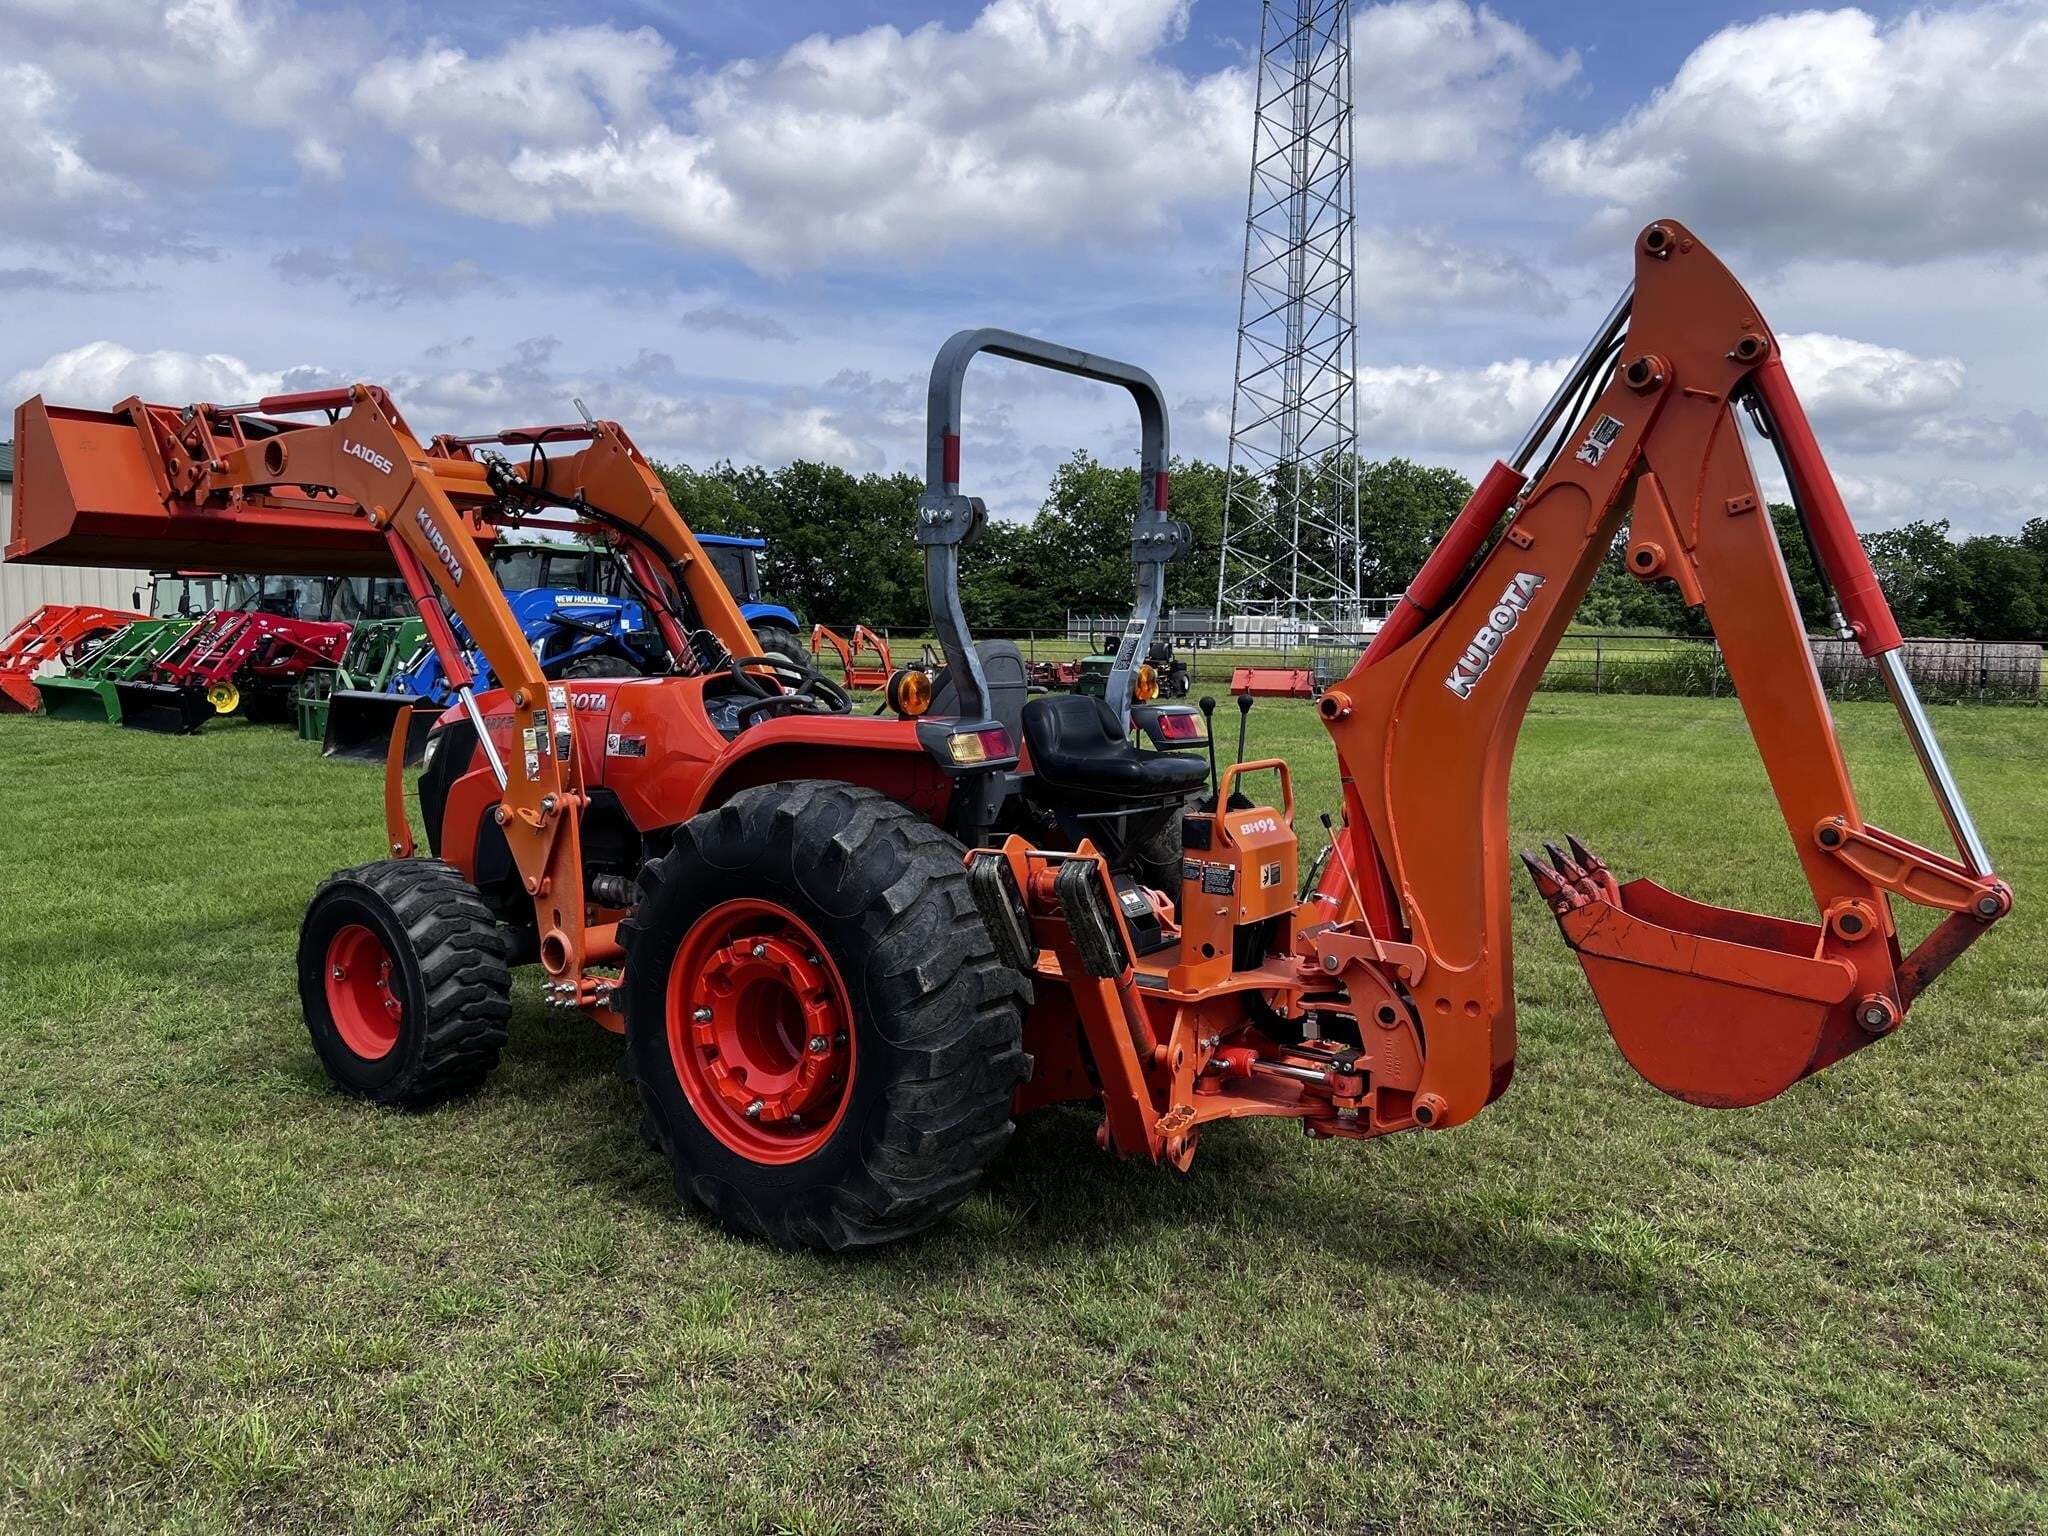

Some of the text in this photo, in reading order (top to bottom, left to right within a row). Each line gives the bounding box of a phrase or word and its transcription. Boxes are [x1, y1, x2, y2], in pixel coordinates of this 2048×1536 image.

[343, 439, 394, 475] LA1065
[416, 507, 464, 587] KUBOTA
[555, 594, 609, 605] NEW HOLLAND
[1443, 571, 1546, 700] KUBOTA
[1240, 817, 1278, 835] BH92
